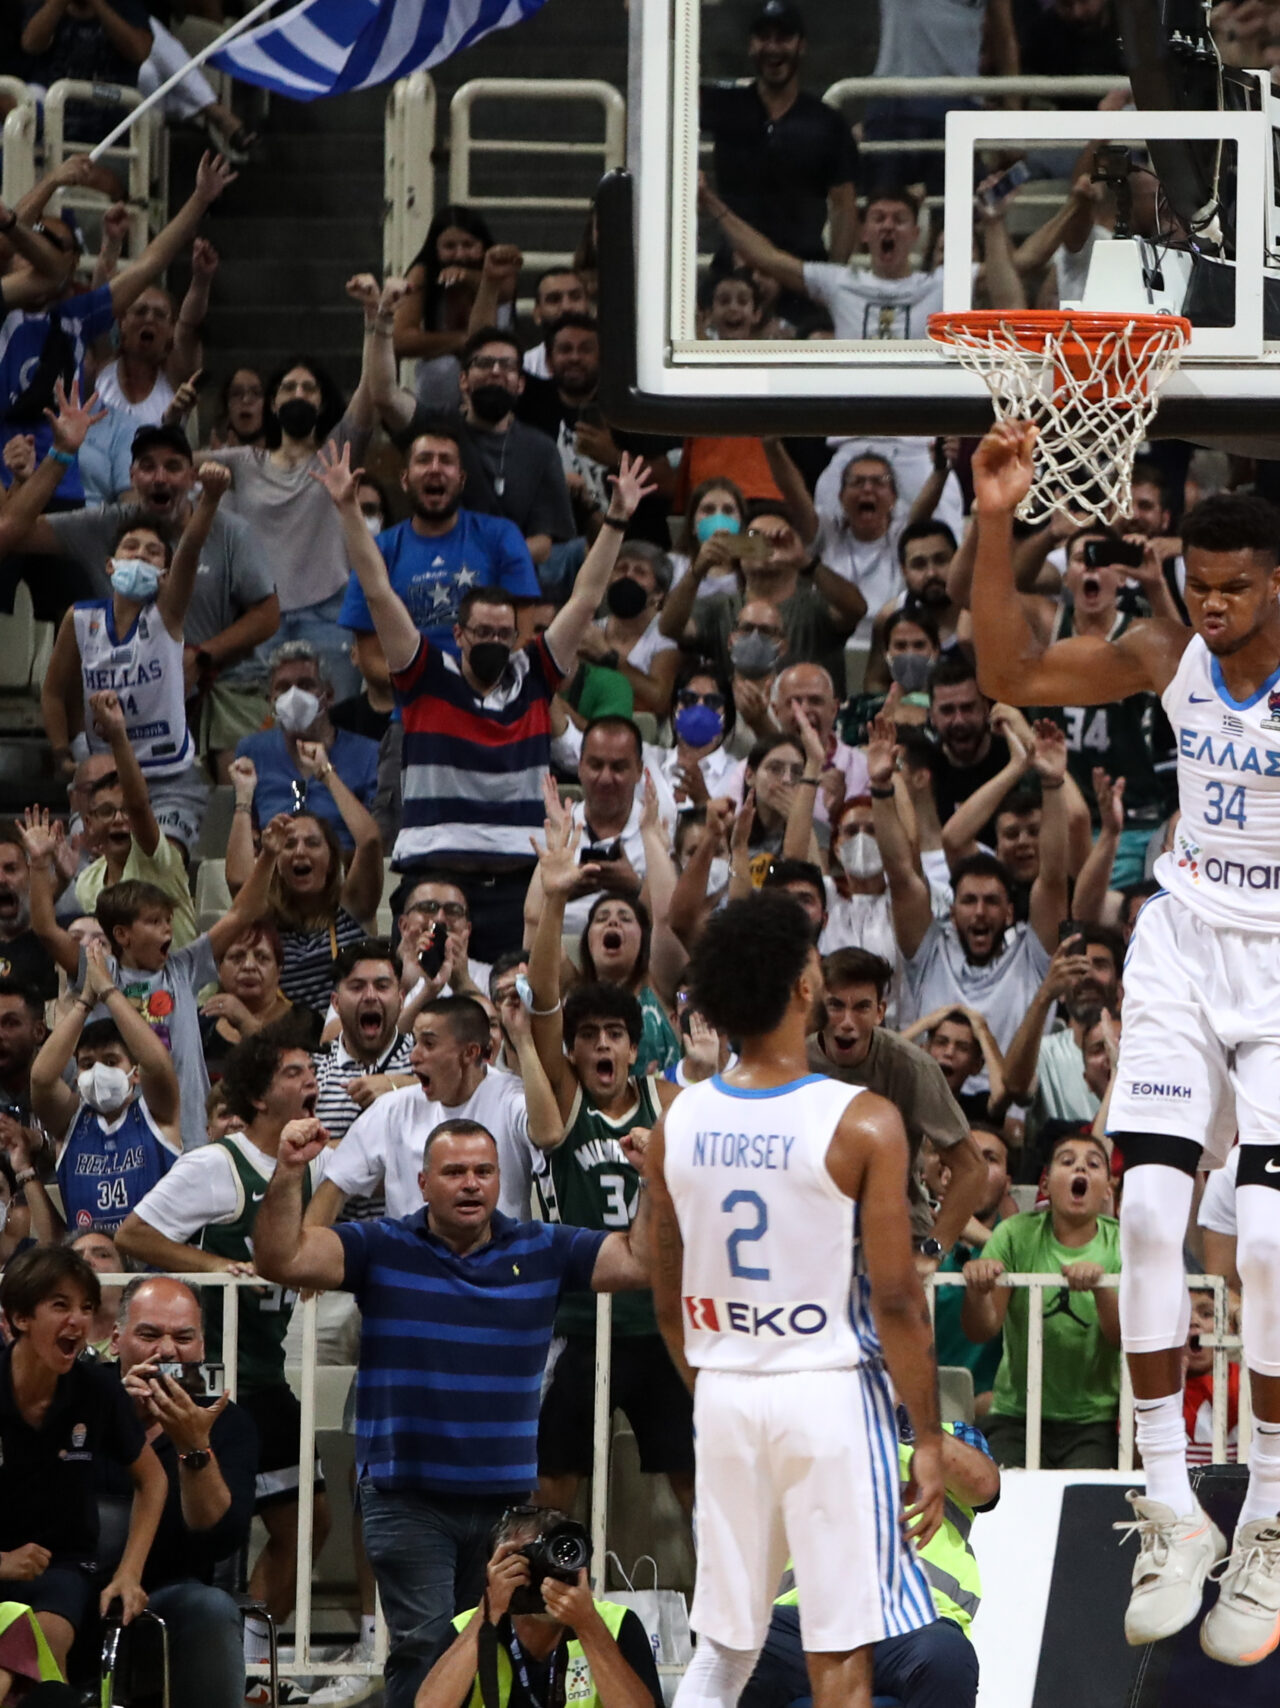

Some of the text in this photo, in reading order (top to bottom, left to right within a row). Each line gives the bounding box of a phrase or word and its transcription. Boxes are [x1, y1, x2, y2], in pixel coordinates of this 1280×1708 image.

[84, 659, 162, 690] HELLAS
[1062, 706, 1111, 752] 34
[1203, 780, 1248, 830] 34
[74, 1145, 145, 1175] HELLAS
[692, 1131, 796, 1171] NTORSEY
[97, 1177, 129, 1210] 34
[721, 1189, 771, 1282] 2
[726, 1301, 828, 1337] EKO
